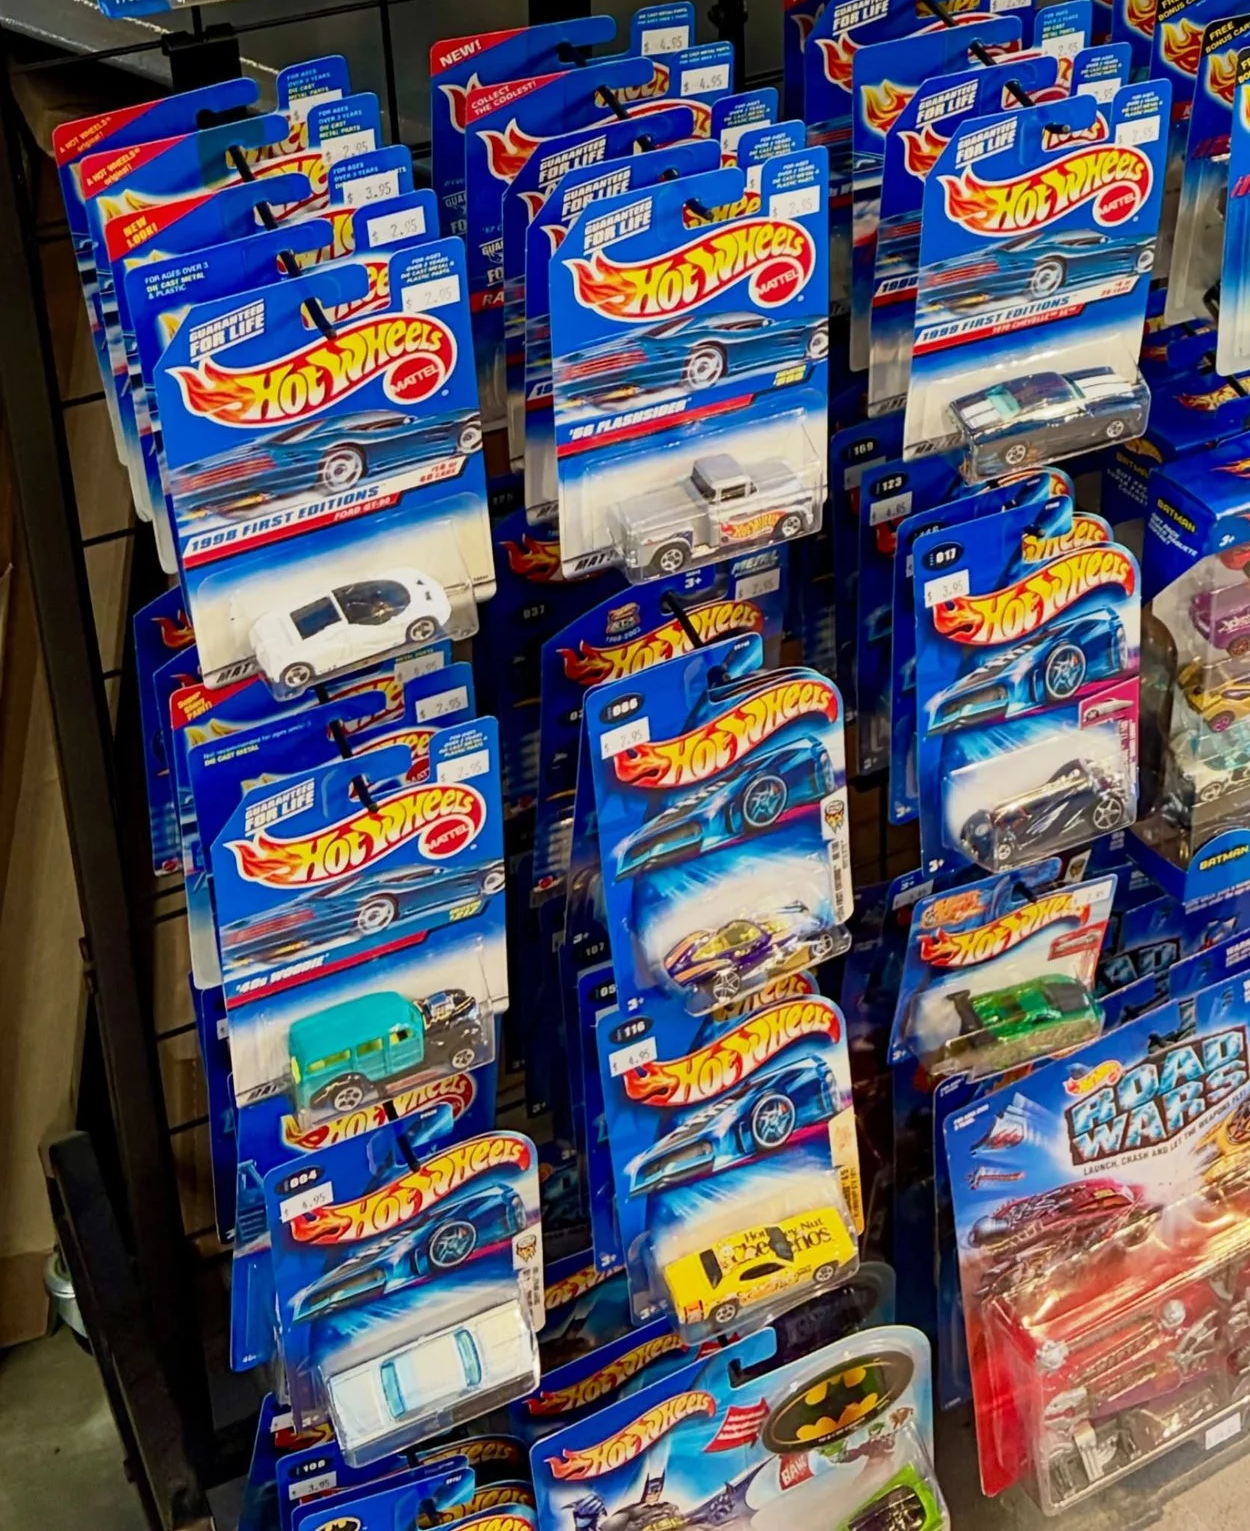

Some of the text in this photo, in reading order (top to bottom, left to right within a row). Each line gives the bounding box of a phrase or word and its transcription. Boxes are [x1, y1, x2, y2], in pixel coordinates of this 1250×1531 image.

[833, 0, 891, 33] FOR LIFE
[439, 38, 482, 68] NEW!
[471, 85, 511, 110] COLLECT
[474, 80, 537, 117] THE COOLEST!
[757, 269, 799, 297] MATTEL
[919, 296, 1071, 343] 1999 FIRST EDITIONS
[392, 363, 440, 394] MATTEL
[189, 484, 381, 553] 1998 FIRST EDITIONS
[1198, 844, 1250, 872] BATMAN
[624, 1021, 646, 1037] 116
[1072, 1033, 1247, 1136] ROAD
[1072, 1060, 1249, 1163] WARS
[1082, 1087, 1249, 1177] LAUNCH, CRASH AND LET THE WEAPONS FLY!
